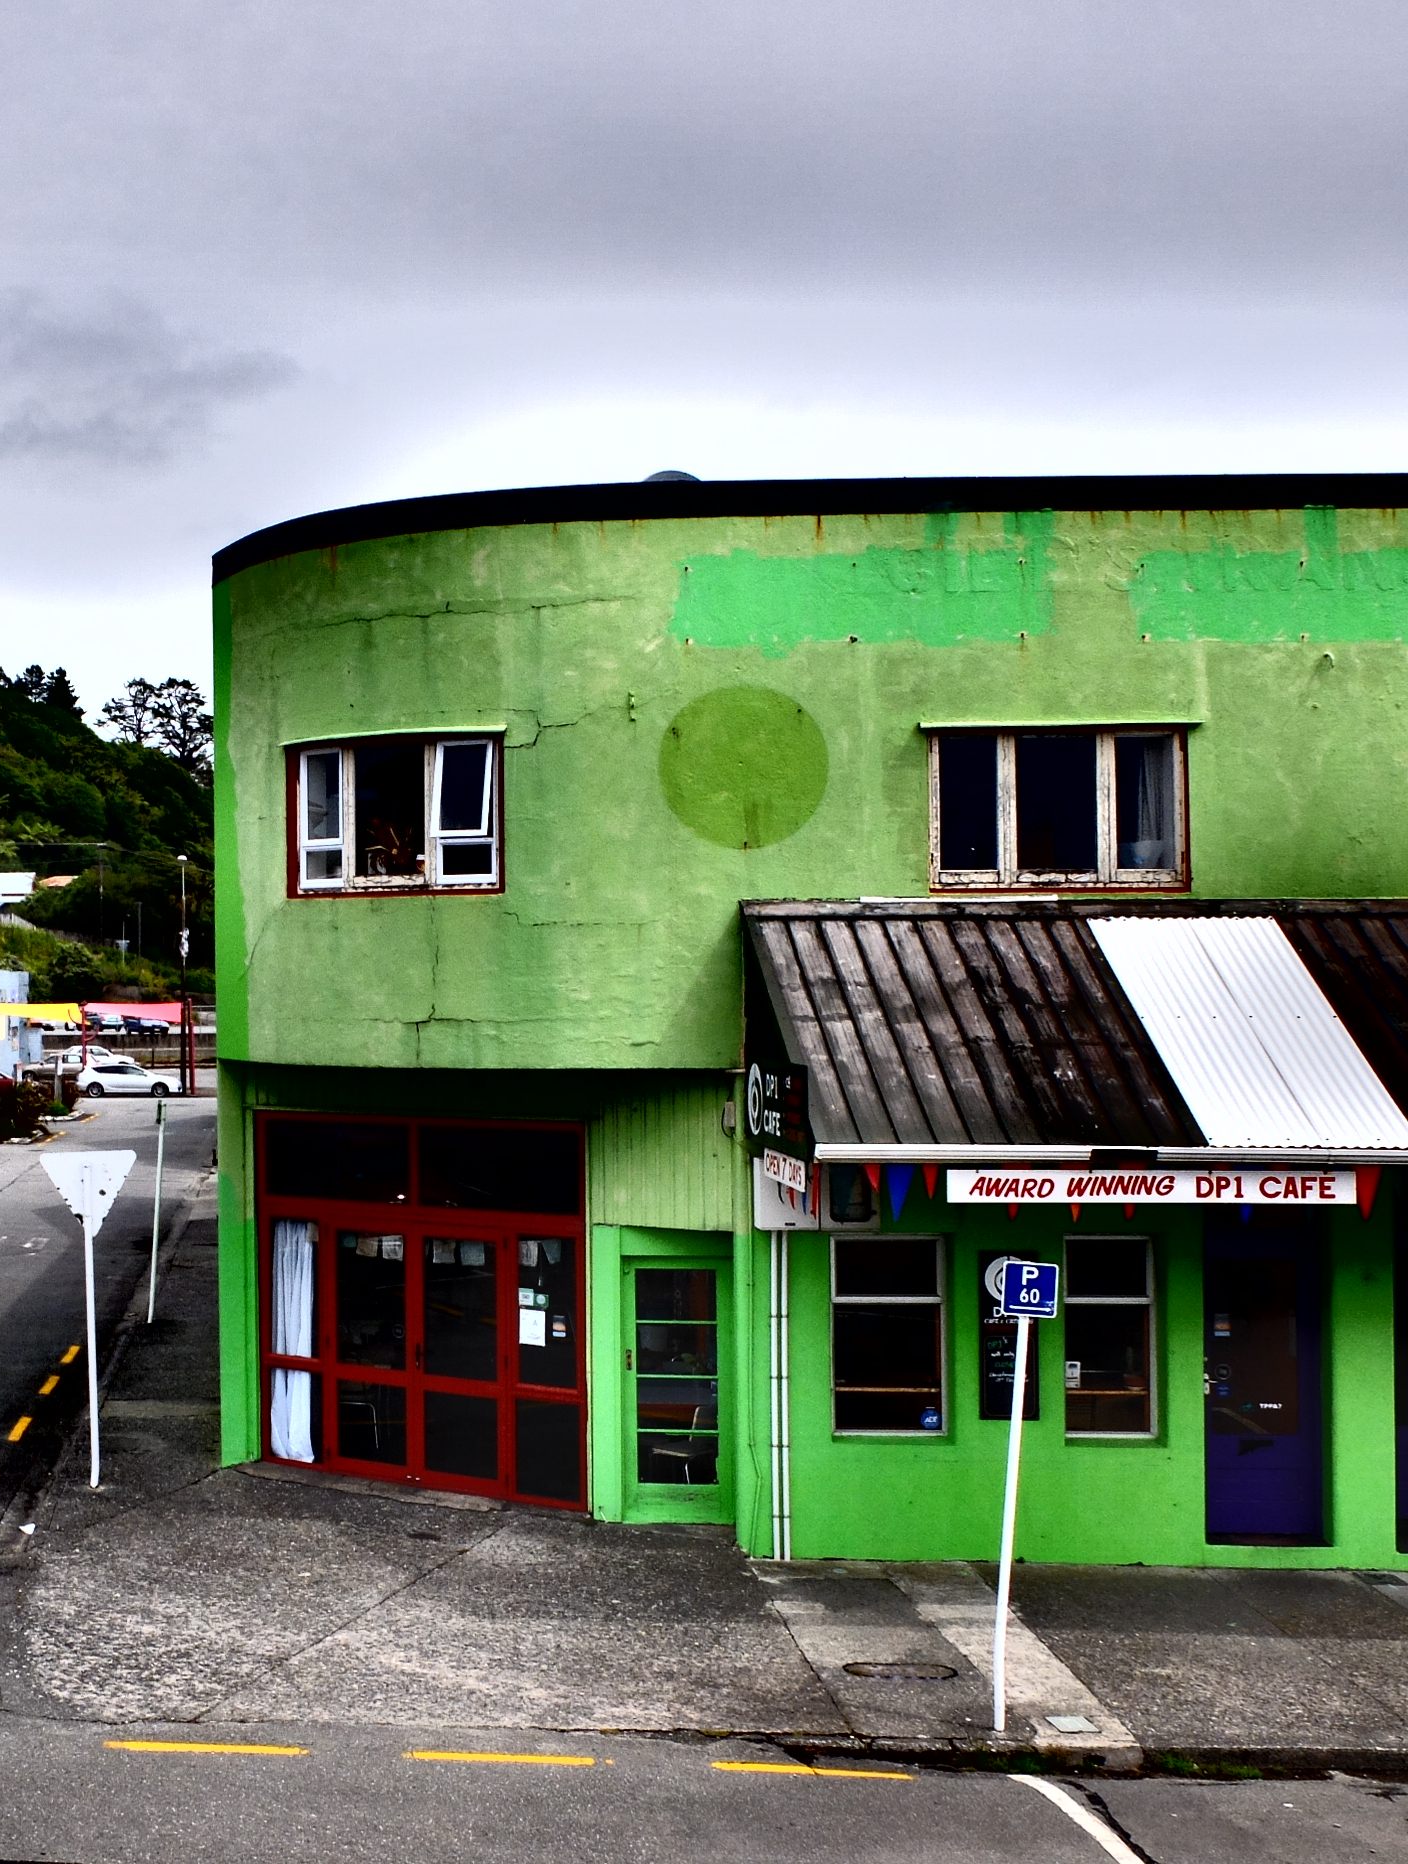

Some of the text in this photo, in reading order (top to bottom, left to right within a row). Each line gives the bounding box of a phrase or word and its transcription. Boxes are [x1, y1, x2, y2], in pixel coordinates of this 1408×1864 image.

[763, 1109, 781, 1137] CAFE
[765, 1152, 802, 1187] OPEN 7 DAYS
[969, 1175, 1336, 1199] AWARD WINNING DP1 CAFE
[1021, 1266, 1039, 1286] P
[1019, 1288, 1040, 1304] 60
